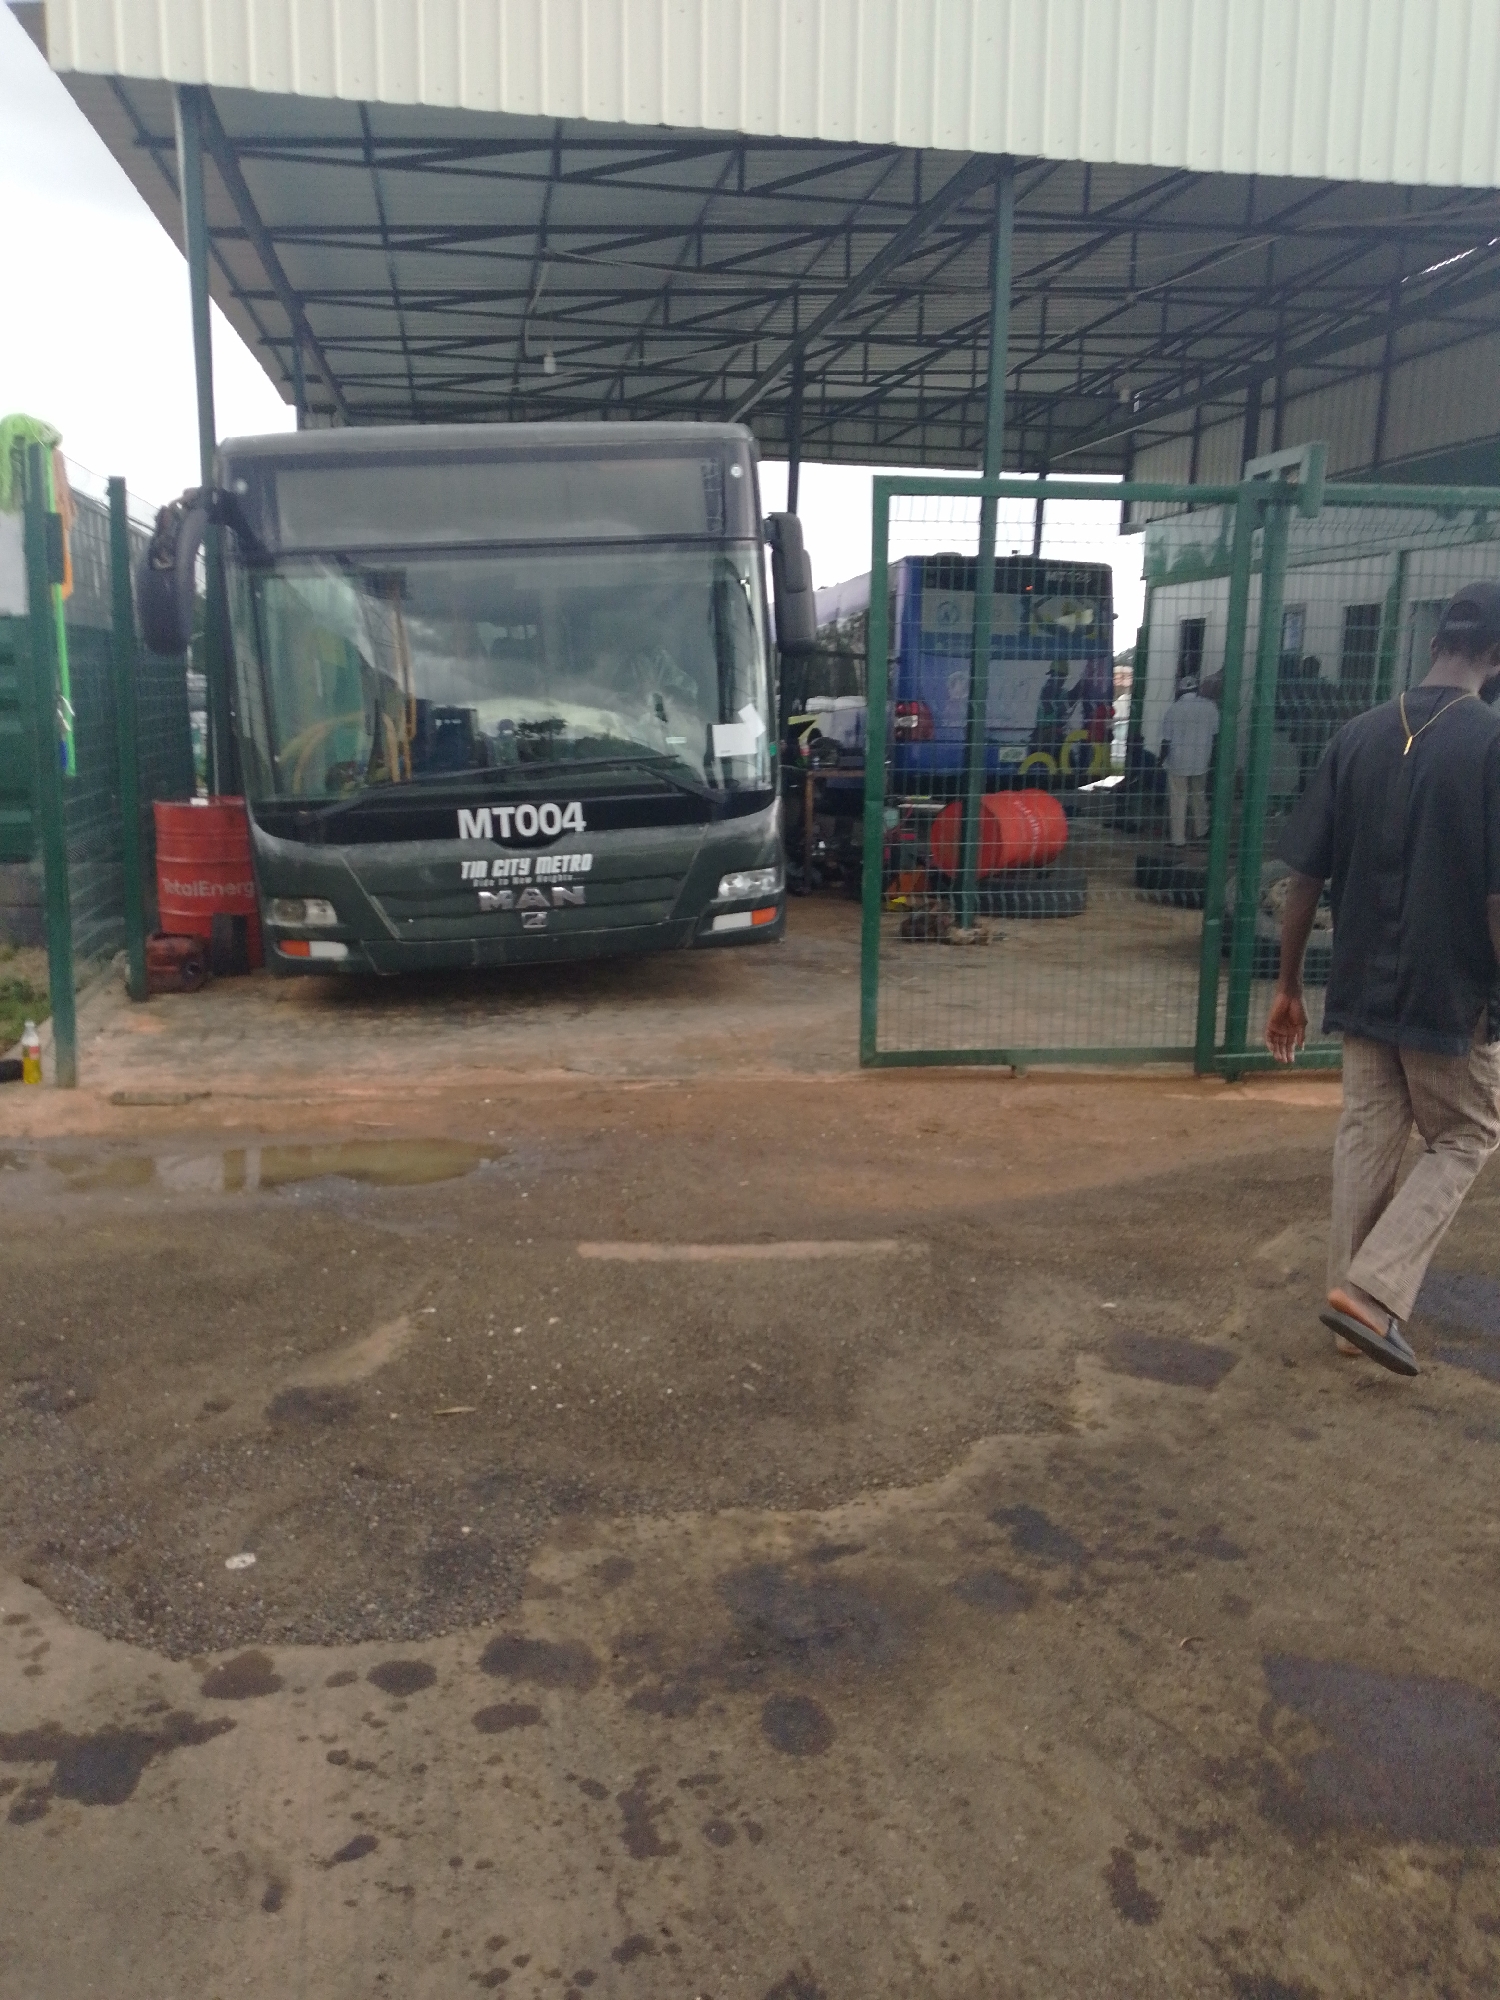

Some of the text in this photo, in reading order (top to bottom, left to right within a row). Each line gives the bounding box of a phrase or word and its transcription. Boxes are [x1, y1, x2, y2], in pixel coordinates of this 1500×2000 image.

[457, 801, 587, 840] MT004
[491, 857, 531, 877] CITY
[535, 853, 593, 875] METRO
[478, 886, 586, 912] MAN
